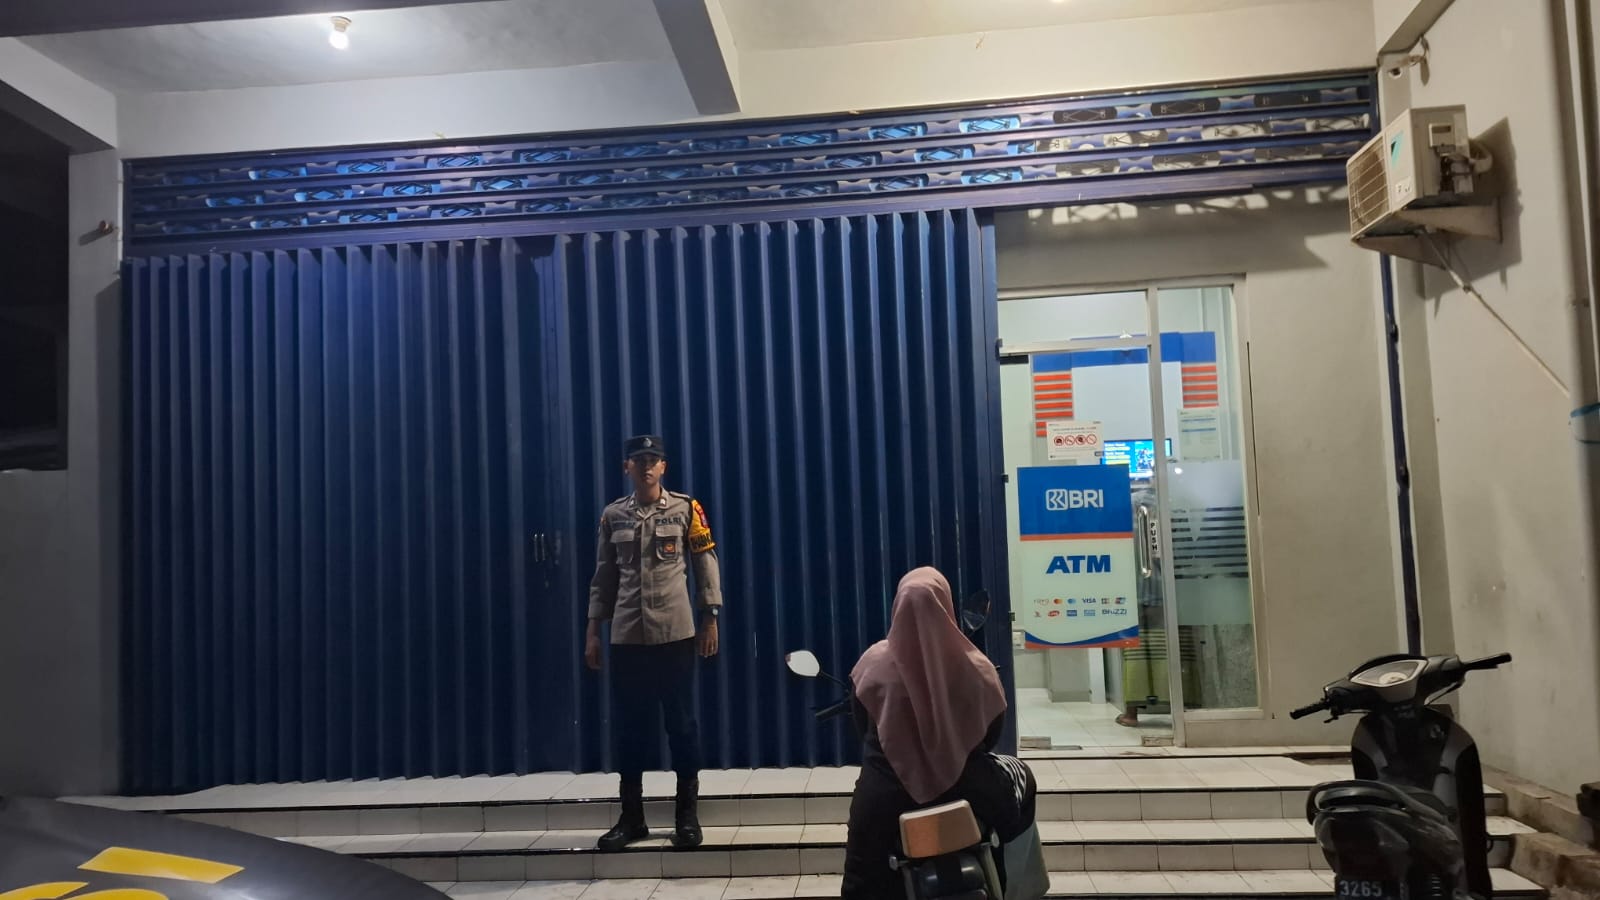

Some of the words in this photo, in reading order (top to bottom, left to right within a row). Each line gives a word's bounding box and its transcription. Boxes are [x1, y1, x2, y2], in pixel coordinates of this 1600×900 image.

[1069, 489, 1104, 508] BRI
[1150, 522, 1158, 551] PUSH
[1046, 555, 1111, 574] ATM
[1339, 879, 1382, 897] 3265
